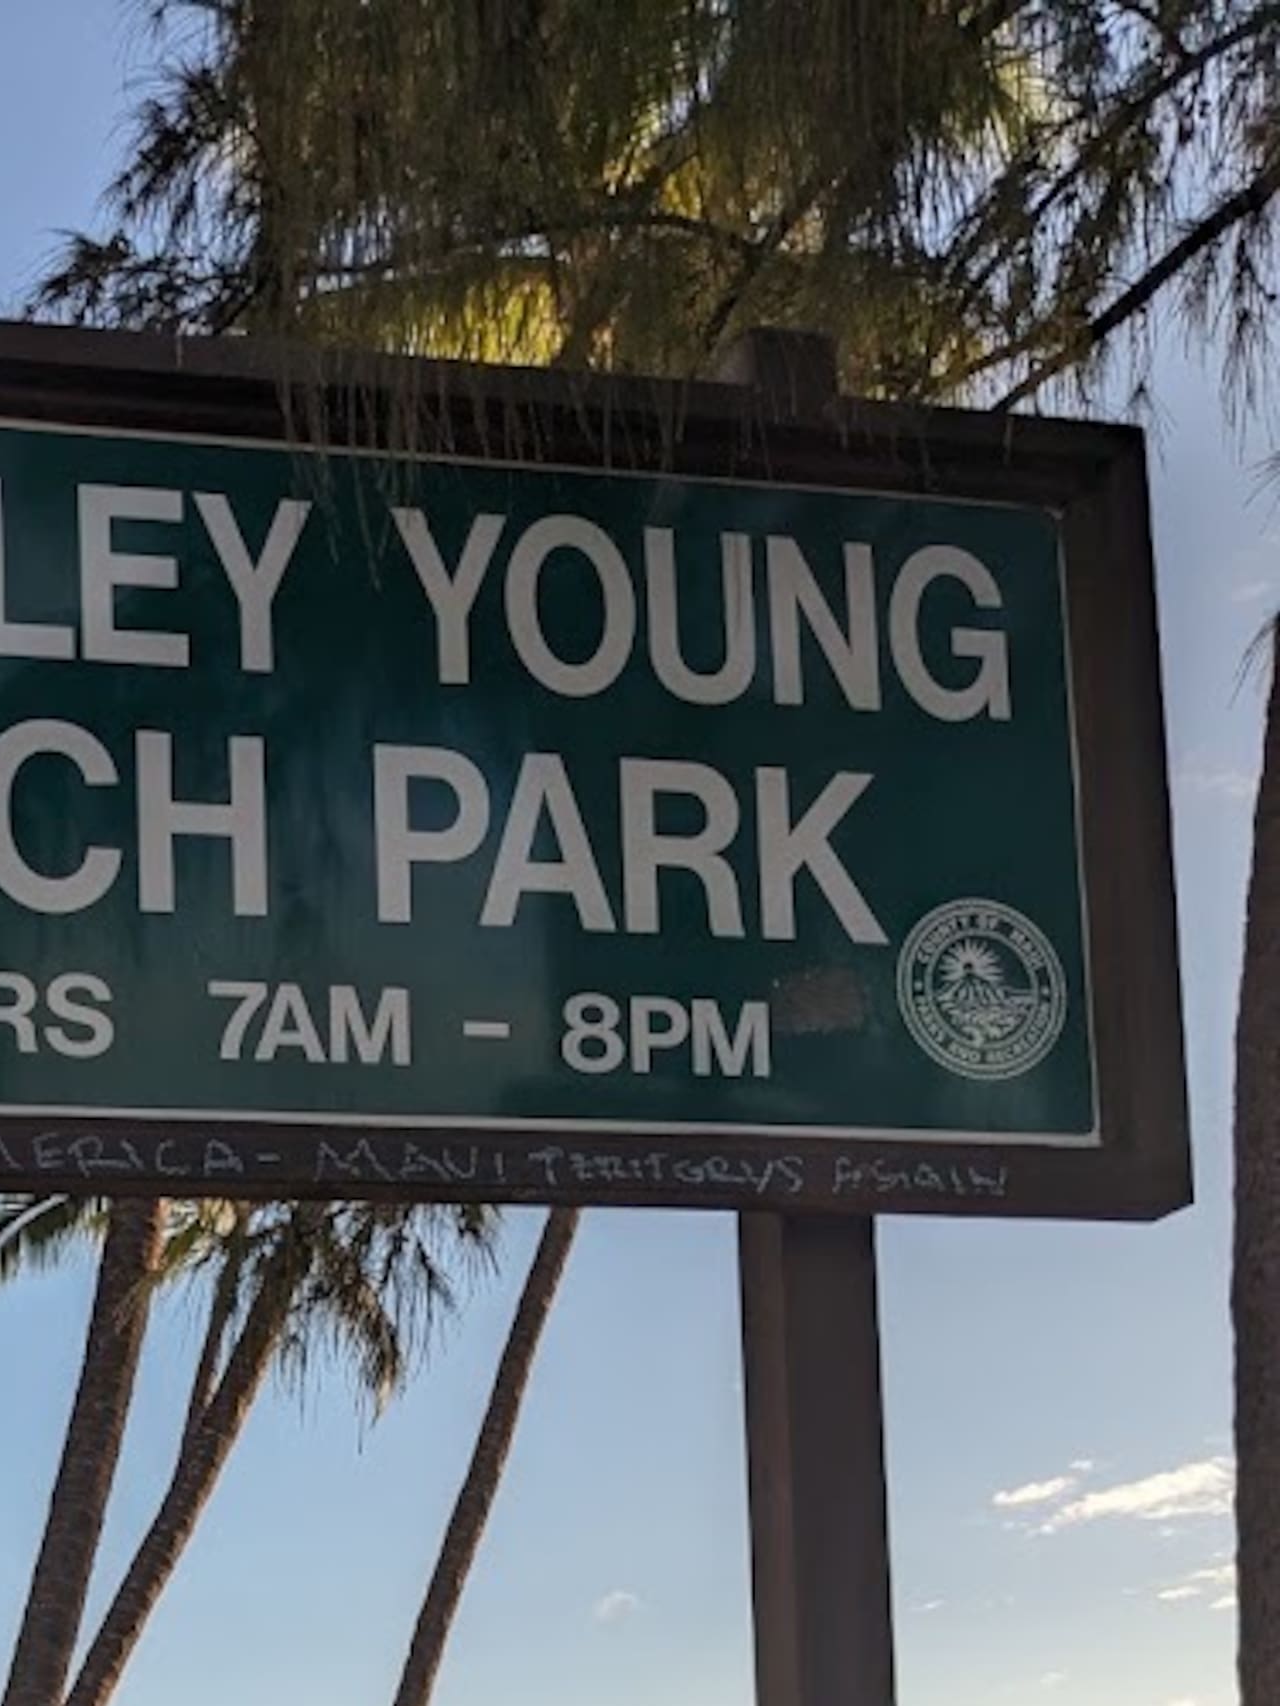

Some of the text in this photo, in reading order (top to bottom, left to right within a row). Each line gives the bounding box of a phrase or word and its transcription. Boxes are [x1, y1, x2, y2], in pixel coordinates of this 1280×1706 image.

[392, 505, 1012, 723] YOUNG
[372, 742, 889, 945] PARK
[207, 980, 412, 1067] 7AM
[560, 992, 772, 1079] 8PM
